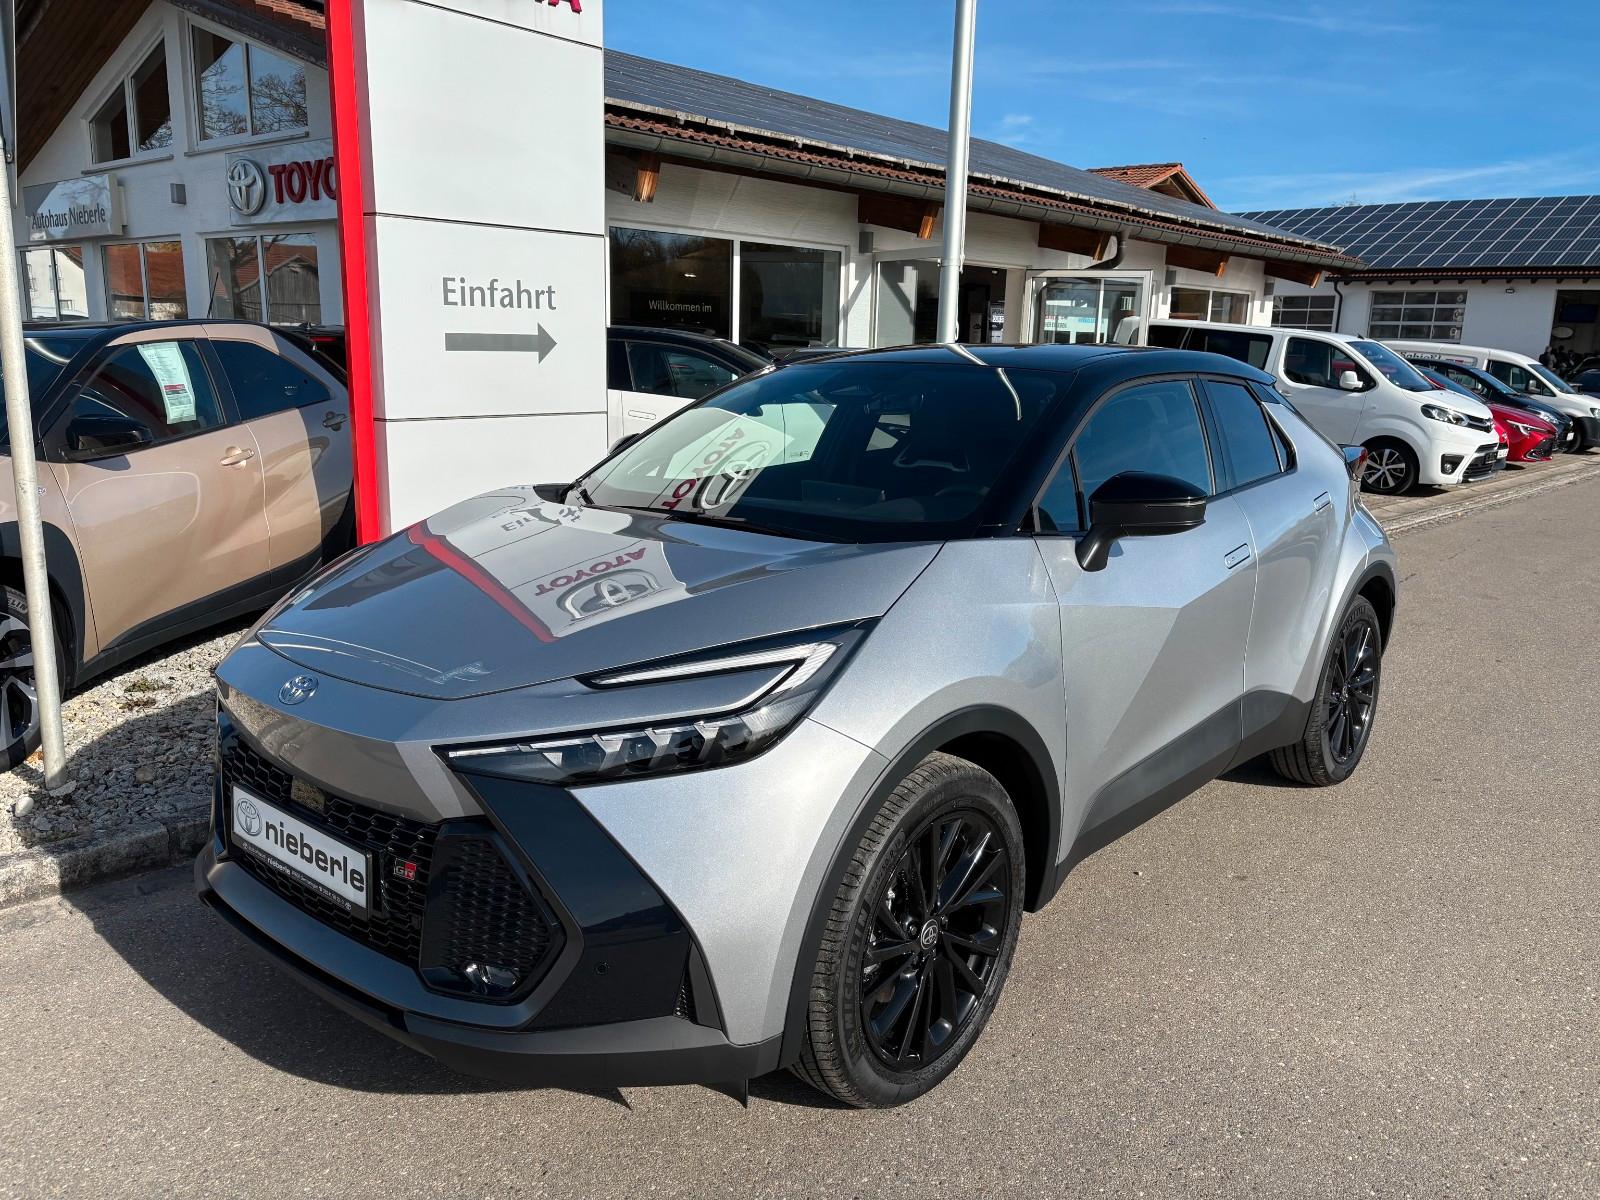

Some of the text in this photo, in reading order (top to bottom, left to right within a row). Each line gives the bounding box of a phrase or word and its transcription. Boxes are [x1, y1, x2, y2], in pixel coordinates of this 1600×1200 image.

[32, 203, 106, 230] Autohaus Nieberle
[442, 277, 557, 310] Einfahrt
[648, 299, 712, 313] Willkommen im
[265, 820, 365, 893] nieberle
[396, 865, 415, 880] GR
